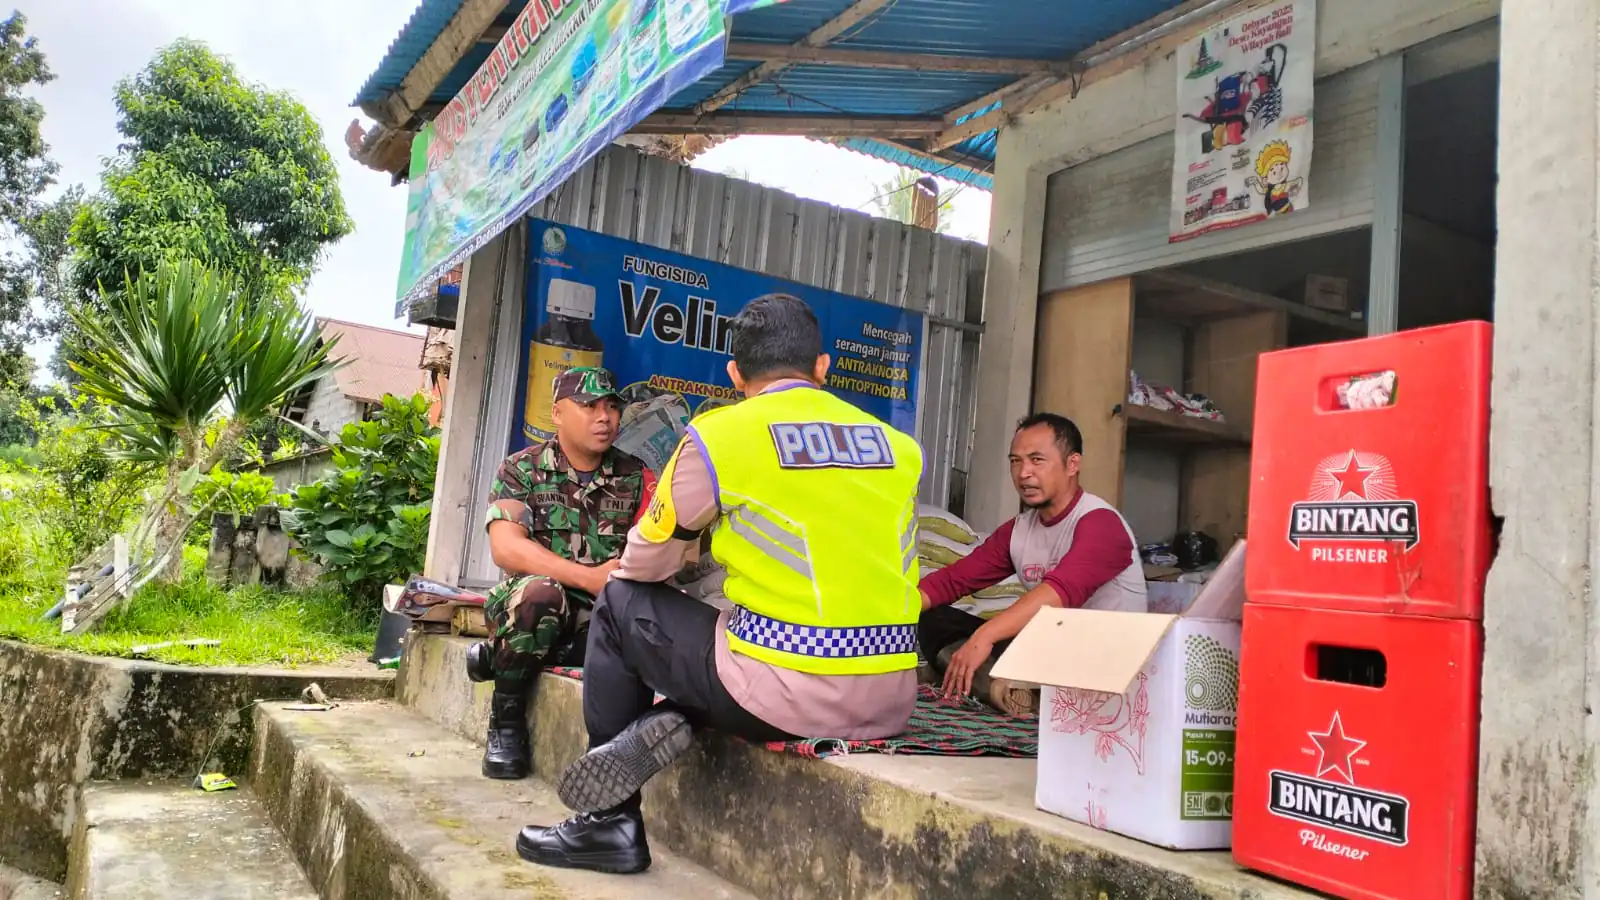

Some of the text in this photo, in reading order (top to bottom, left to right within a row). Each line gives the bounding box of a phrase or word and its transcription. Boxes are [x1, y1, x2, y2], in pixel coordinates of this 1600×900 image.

[623, 255, 709, 290] FUNGISIDA
[862, 323, 912, 346] Mencegah
[835, 339, 910, 362] serangan jamur
[836, 357, 908, 381] ANTRAKNOSA
[648, 374, 738, 400] ANTRAKNOSA
[830, 374, 907, 399] PHYTOPTHORA
[776, 424, 892, 463] POLISI
[605, 501, 624, 513] TNI
[1296, 507, 1409, 533] BINTANG
[1312, 548, 1388, 563] PILSENER
[1184, 712, 1231, 725] Mutiara
[1185, 749, 1233, 766] 15-09-
[1187, 796, 1202, 809] SNI
[1279, 780, 1392, 834] BINTANG
[1299, 829, 1369, 860] Pilsener
